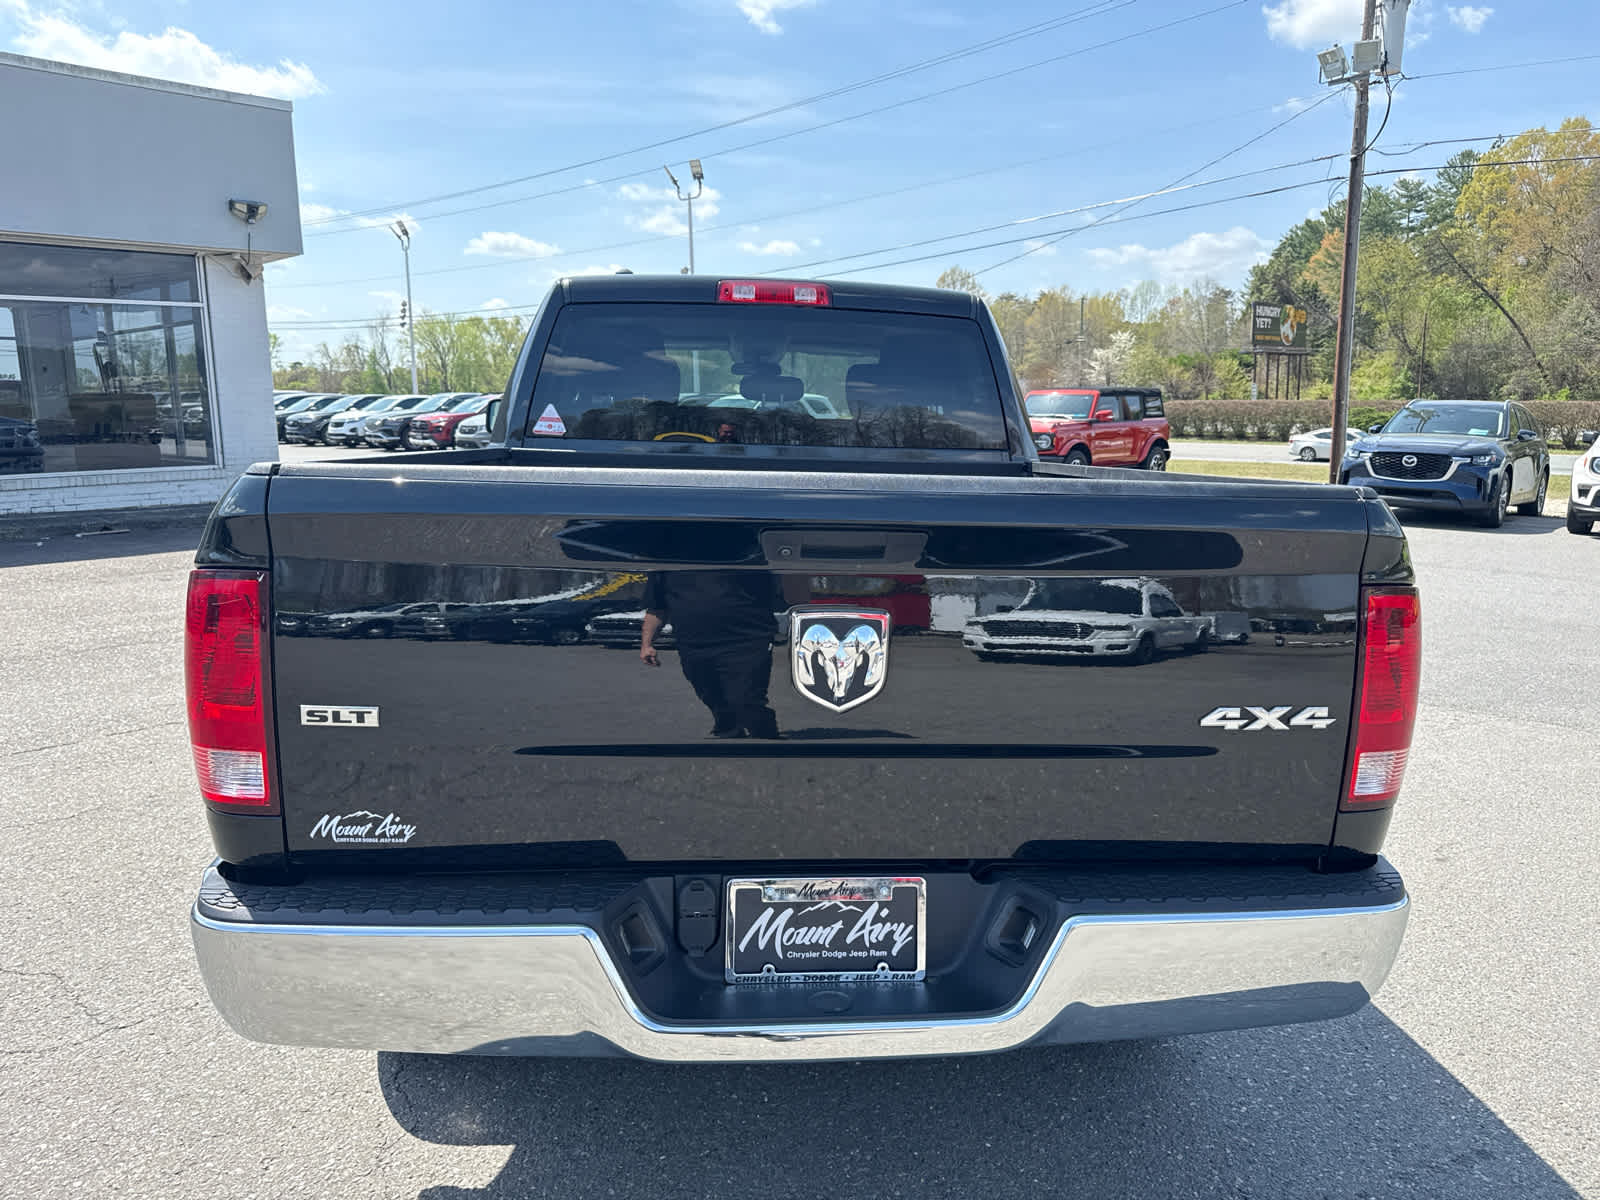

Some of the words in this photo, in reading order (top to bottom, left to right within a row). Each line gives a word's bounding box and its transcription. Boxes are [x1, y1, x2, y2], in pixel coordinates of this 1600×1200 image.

[1255, 317, 1272, 329] YET?
[306, 709, 373, 724] SLT
[1200, 706, 1337, 731] 4X4
[310, 814, 373, 843] Mount
[375, 813, 417, 843] Airy
[738, 907, 844, 959] Mount
[846, 901, 914, 956] Airy
[787, 950, 820, 960] Chrysler
[822, 950, 847, 959] Dodge
[849, 950, 867, 958] Jeep
